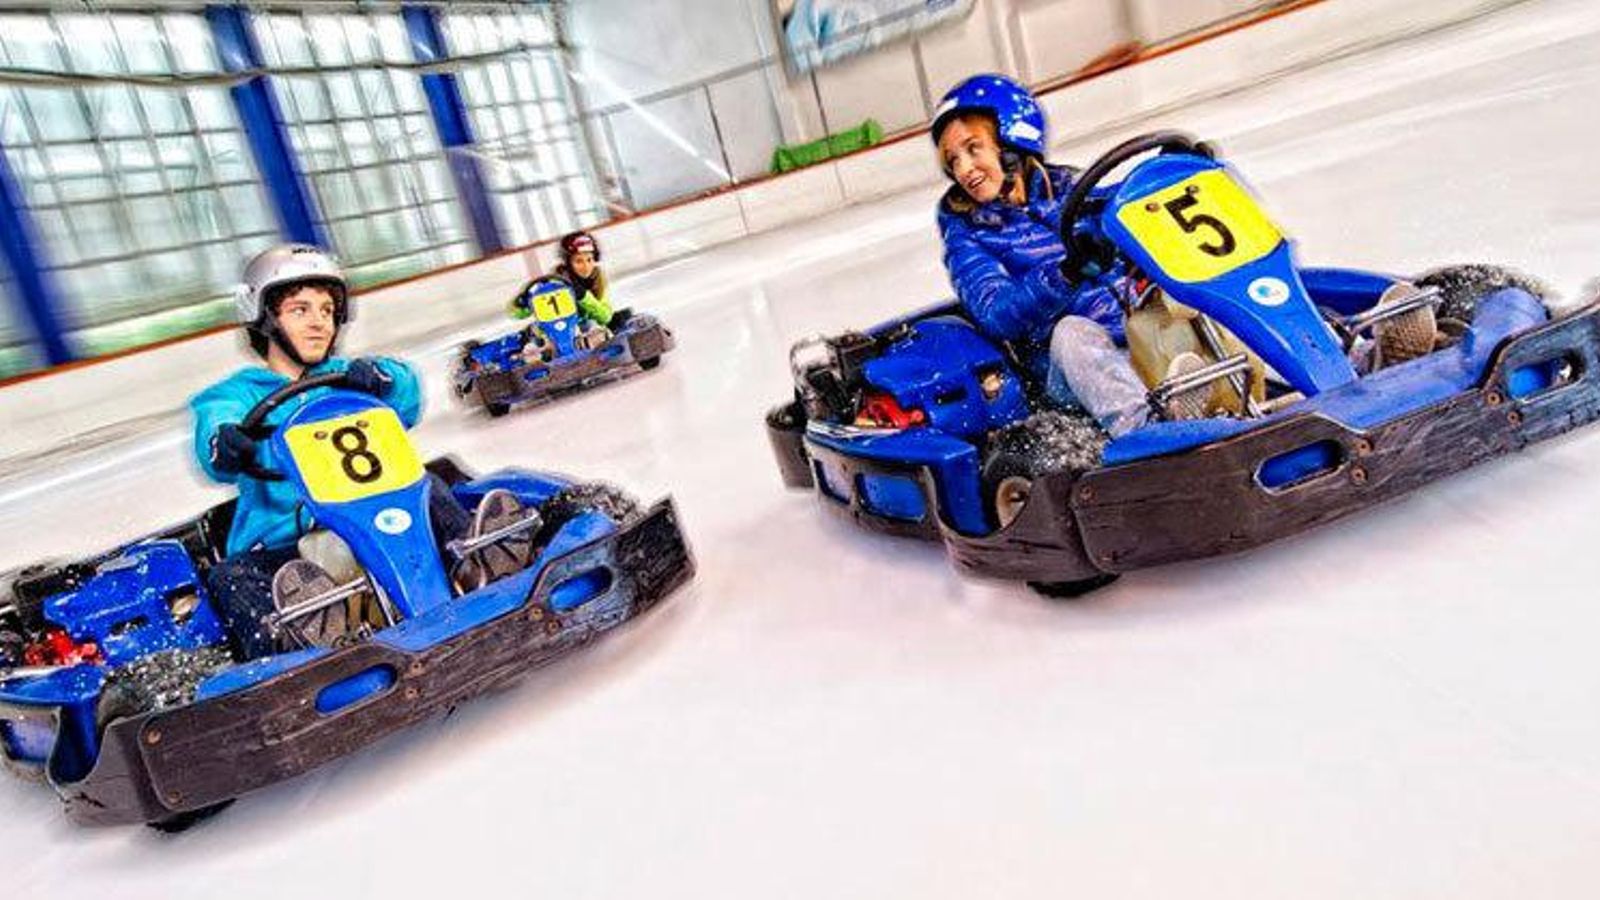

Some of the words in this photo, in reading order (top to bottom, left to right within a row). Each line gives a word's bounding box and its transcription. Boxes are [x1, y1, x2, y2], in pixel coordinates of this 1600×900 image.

[1164, 193, 1236, 257] 5
[547, 296, 560, 316] 1
[331, 426, 383, 484] 8
